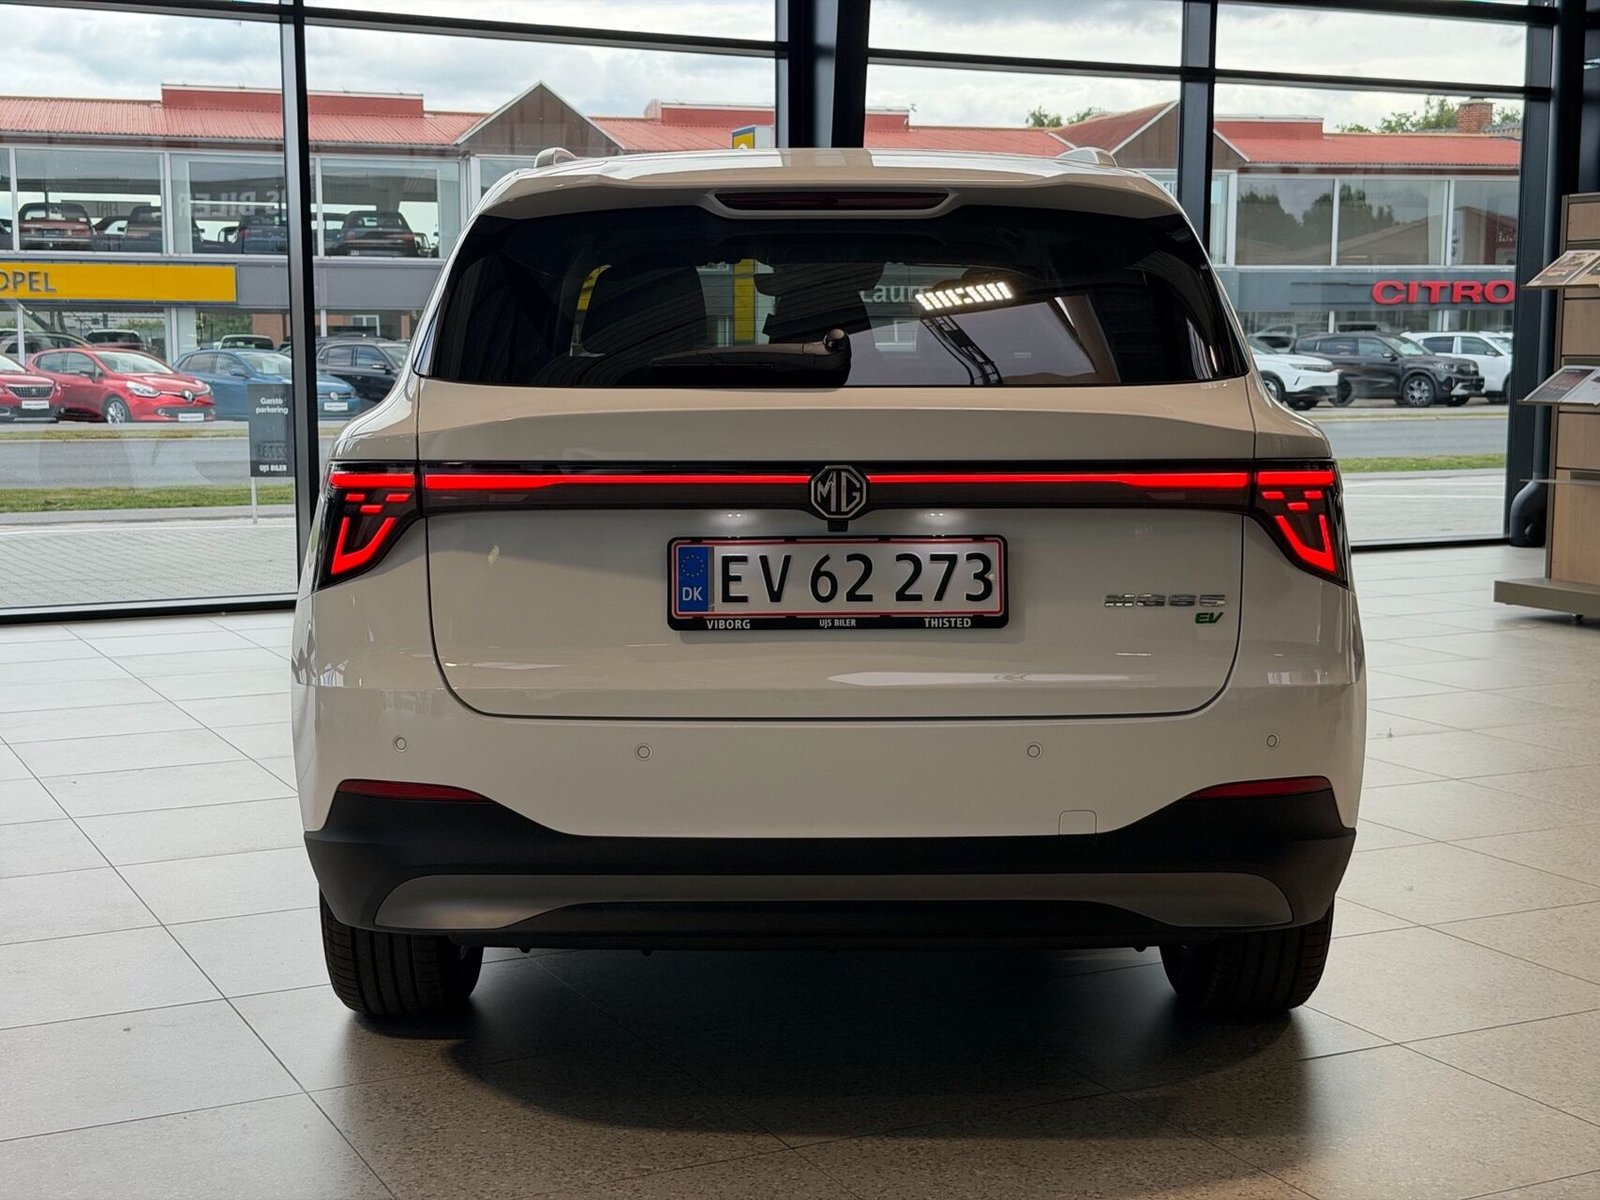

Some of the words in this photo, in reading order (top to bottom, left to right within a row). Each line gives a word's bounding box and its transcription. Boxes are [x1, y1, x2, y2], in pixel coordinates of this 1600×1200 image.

[256, 406, 288, 415] parkering
[817, 471, 861, 512] MG
[721, 554, 792, 603] EV
[810, 553, 874, 603] 62
[895, 552, 993, 602] 273
[682, 586, 703, 601] DK
[819, 619, 832, 629] UJS
[834, 618, 857, 627] BILER
[924, 617, 972, 628] THISTED
[1195, 612, 1224, 624] EV
[706, 619, 751, 629] VIBORG
